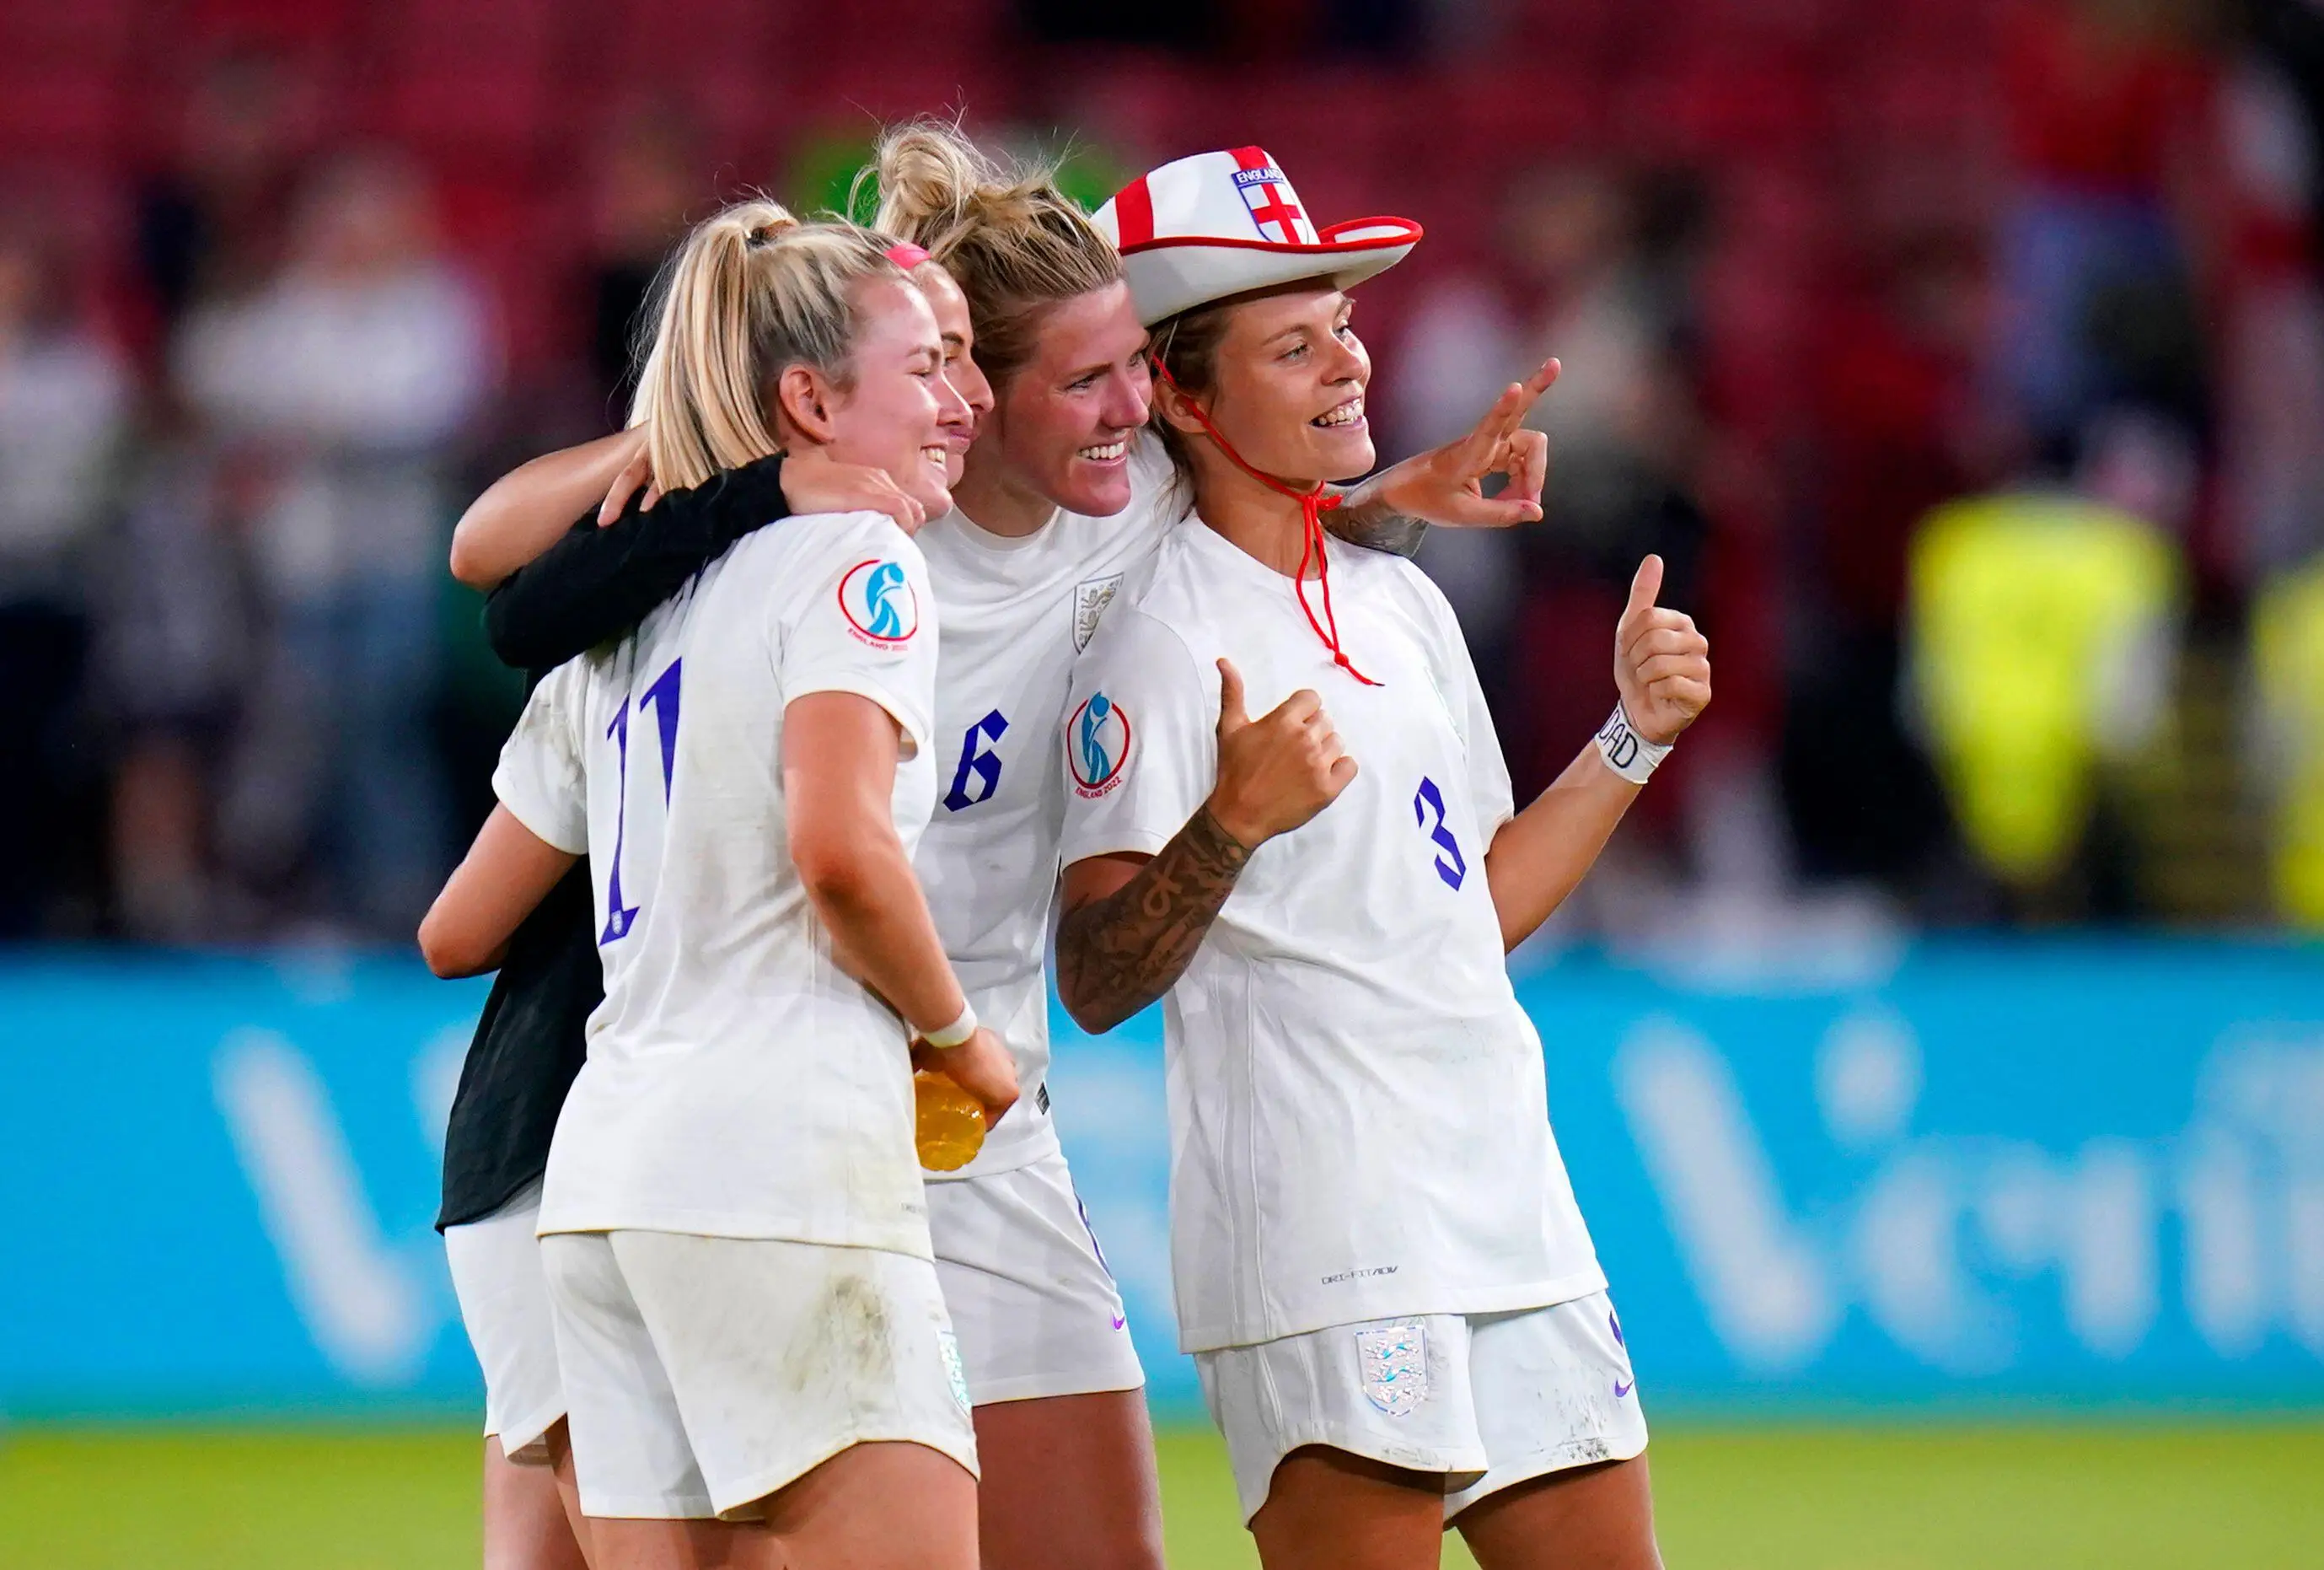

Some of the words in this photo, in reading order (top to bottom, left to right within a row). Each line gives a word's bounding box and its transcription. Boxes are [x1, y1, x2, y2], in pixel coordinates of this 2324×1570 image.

[1236, 168, 1282, 183] ENGLAND
[599, 656, 682, 947] 11
[942, 708, 1009, 812] 6
[1103, 776, 1123, 793] 2022
[1414, 775, 1467, 892] 3
